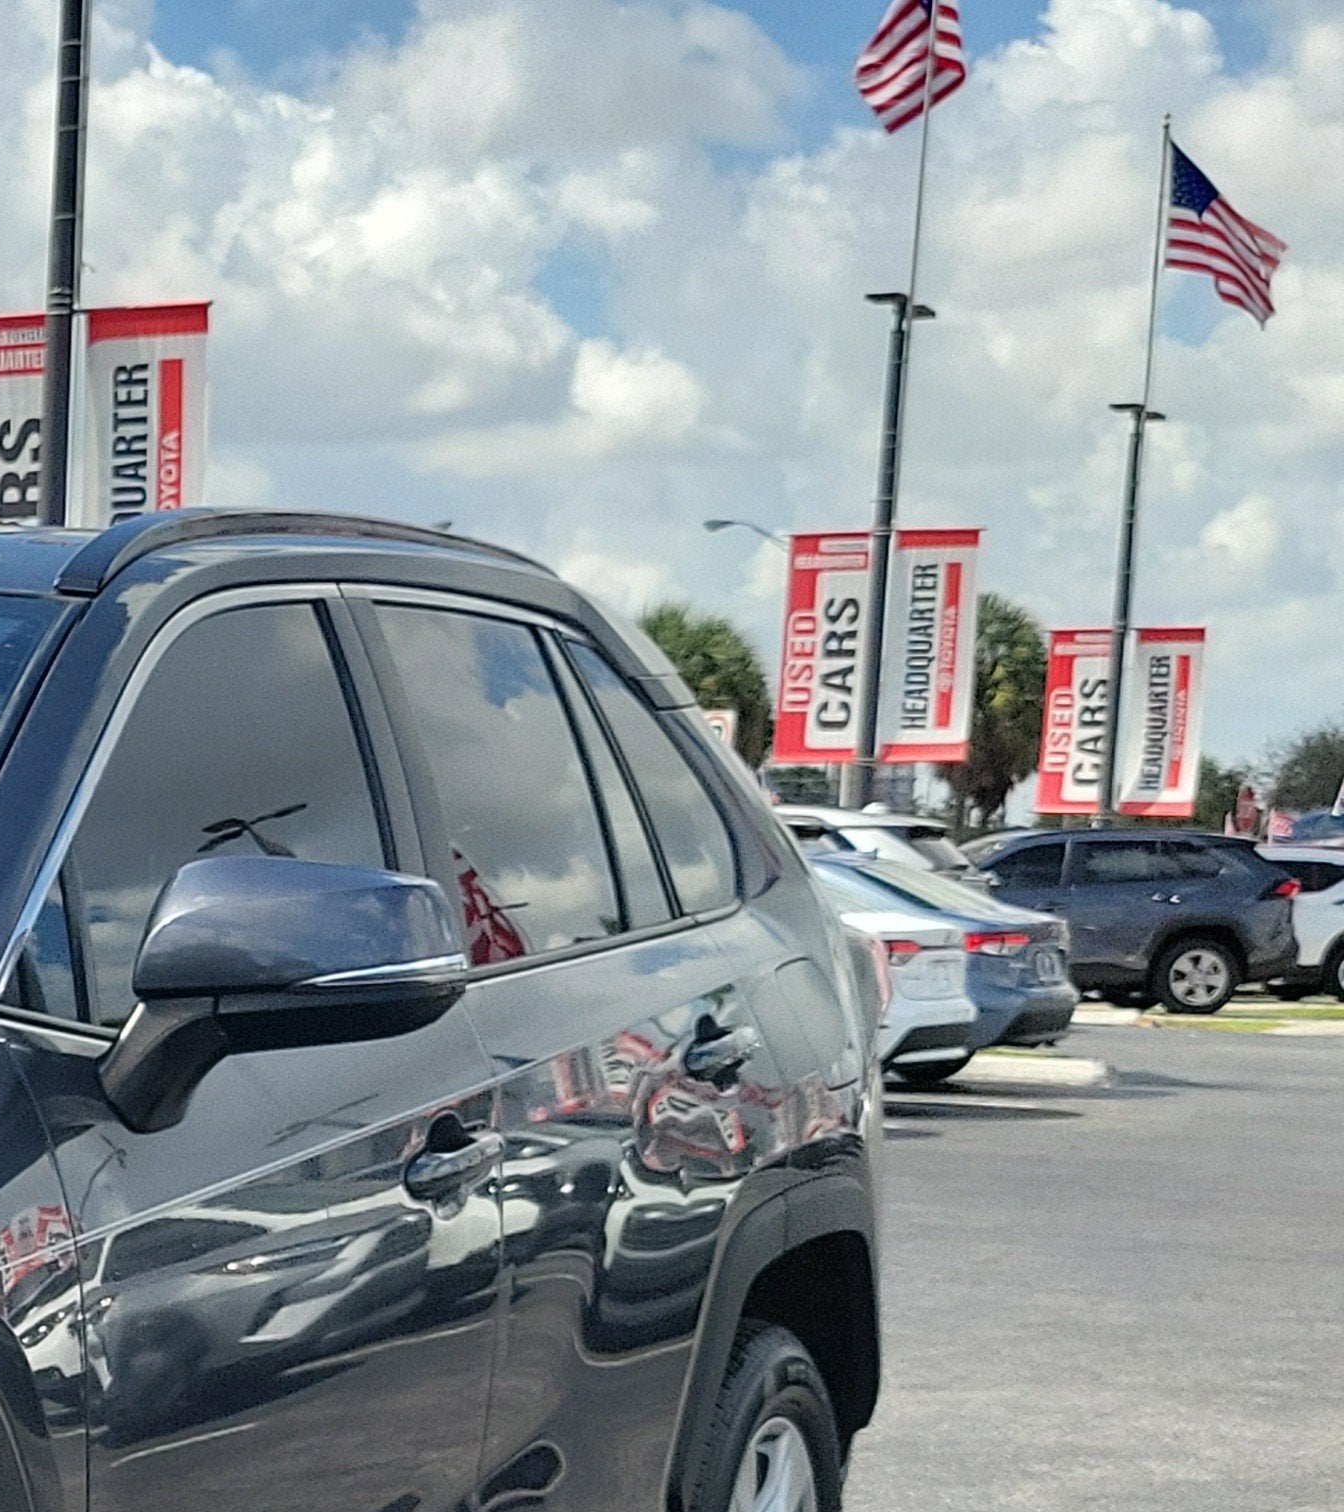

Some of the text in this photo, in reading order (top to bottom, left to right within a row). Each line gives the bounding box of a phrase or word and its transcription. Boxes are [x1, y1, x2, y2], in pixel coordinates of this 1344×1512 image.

[111, 362, 150, 527] UARTER
[158, 432, 181, 510] OYOTA
[784, 613, 816, 708] USED
[816, 597, 860, 731] CARS
[901, 563, 938, 730] HEADQUARTER
[1047, 692, 1074, 768] USED
[1073, 677, 1110, 785] CARS
[1139, 655, 1171, 791] HEADQUARTER
